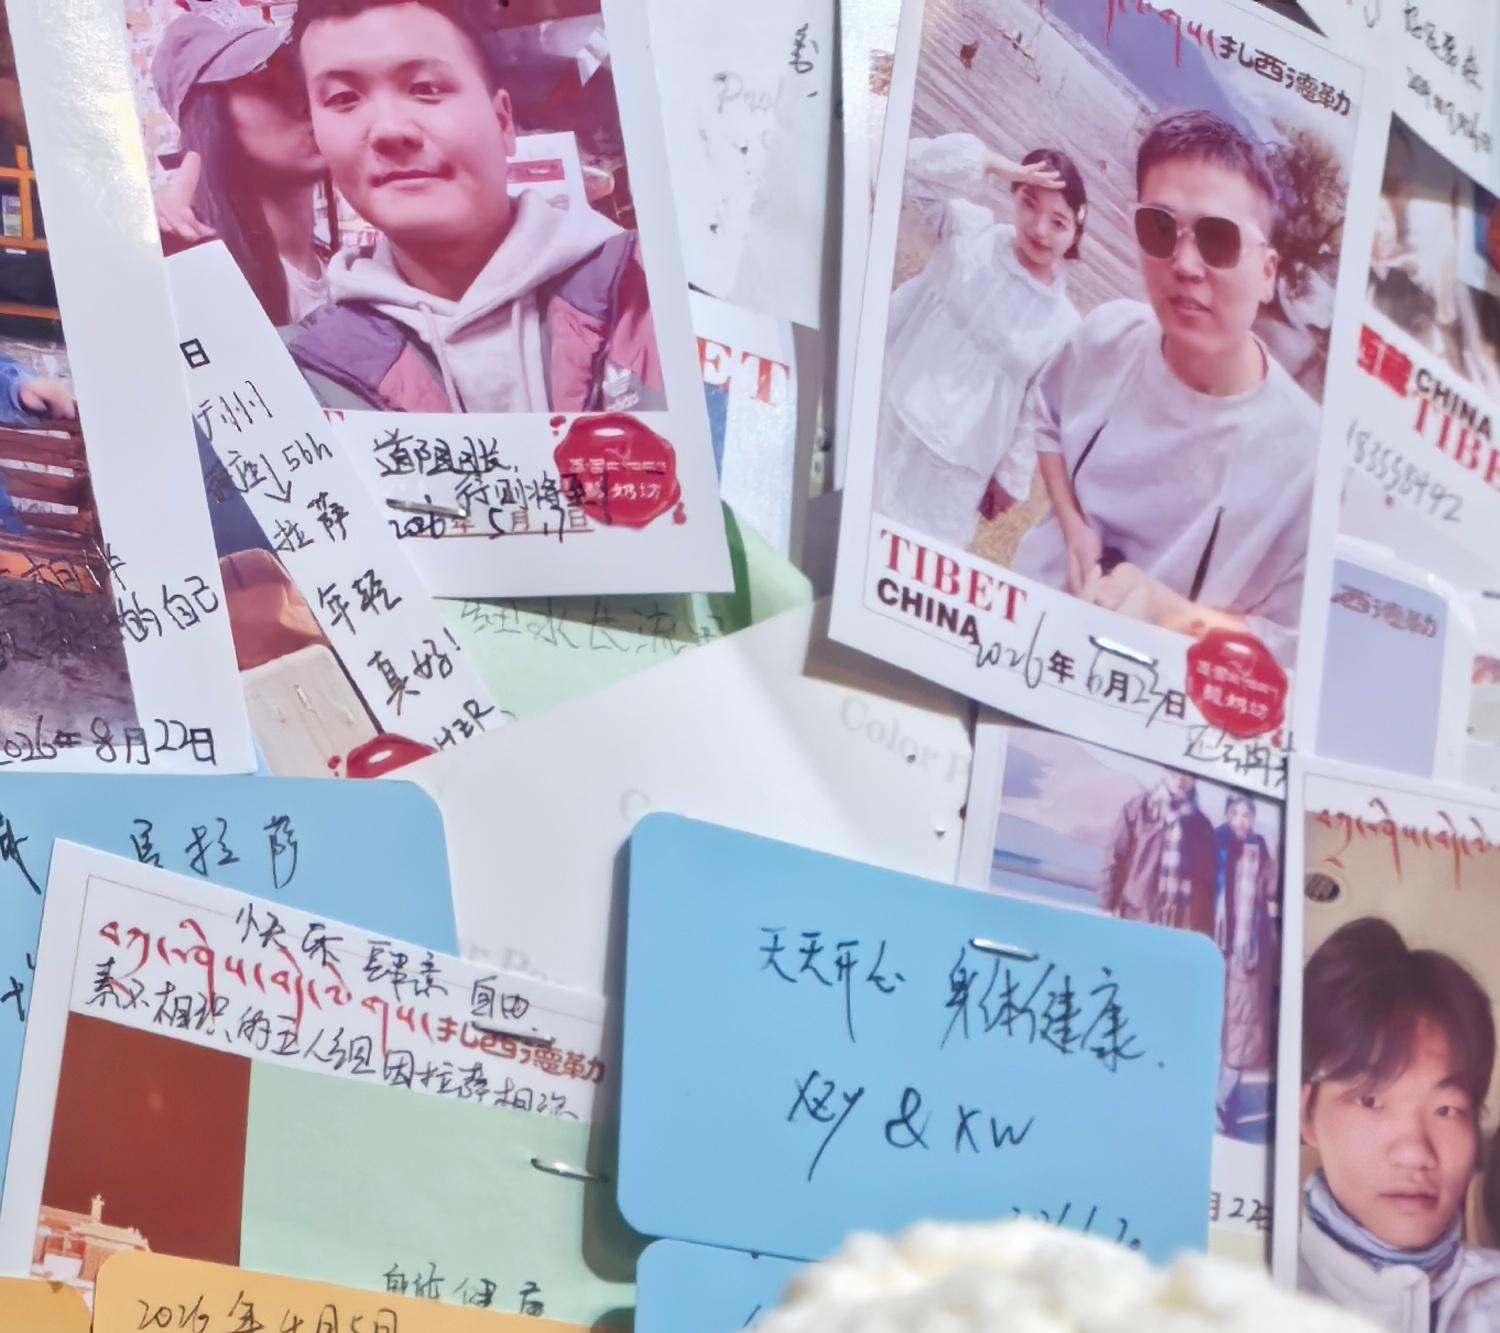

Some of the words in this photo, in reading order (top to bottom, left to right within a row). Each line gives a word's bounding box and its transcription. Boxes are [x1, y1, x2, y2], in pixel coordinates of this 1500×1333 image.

[180, 339, 210, 369] 日
[1416, 368, 1493, 440] CHINA
[318, 569, 403, 635] 年轻
[880, 529, 1027, 623] TIBET
[877, 577, 980, 645] CHINA
[760, 927, 906, 1044] 天天开心
[884, 1087, 930, 1151] &
